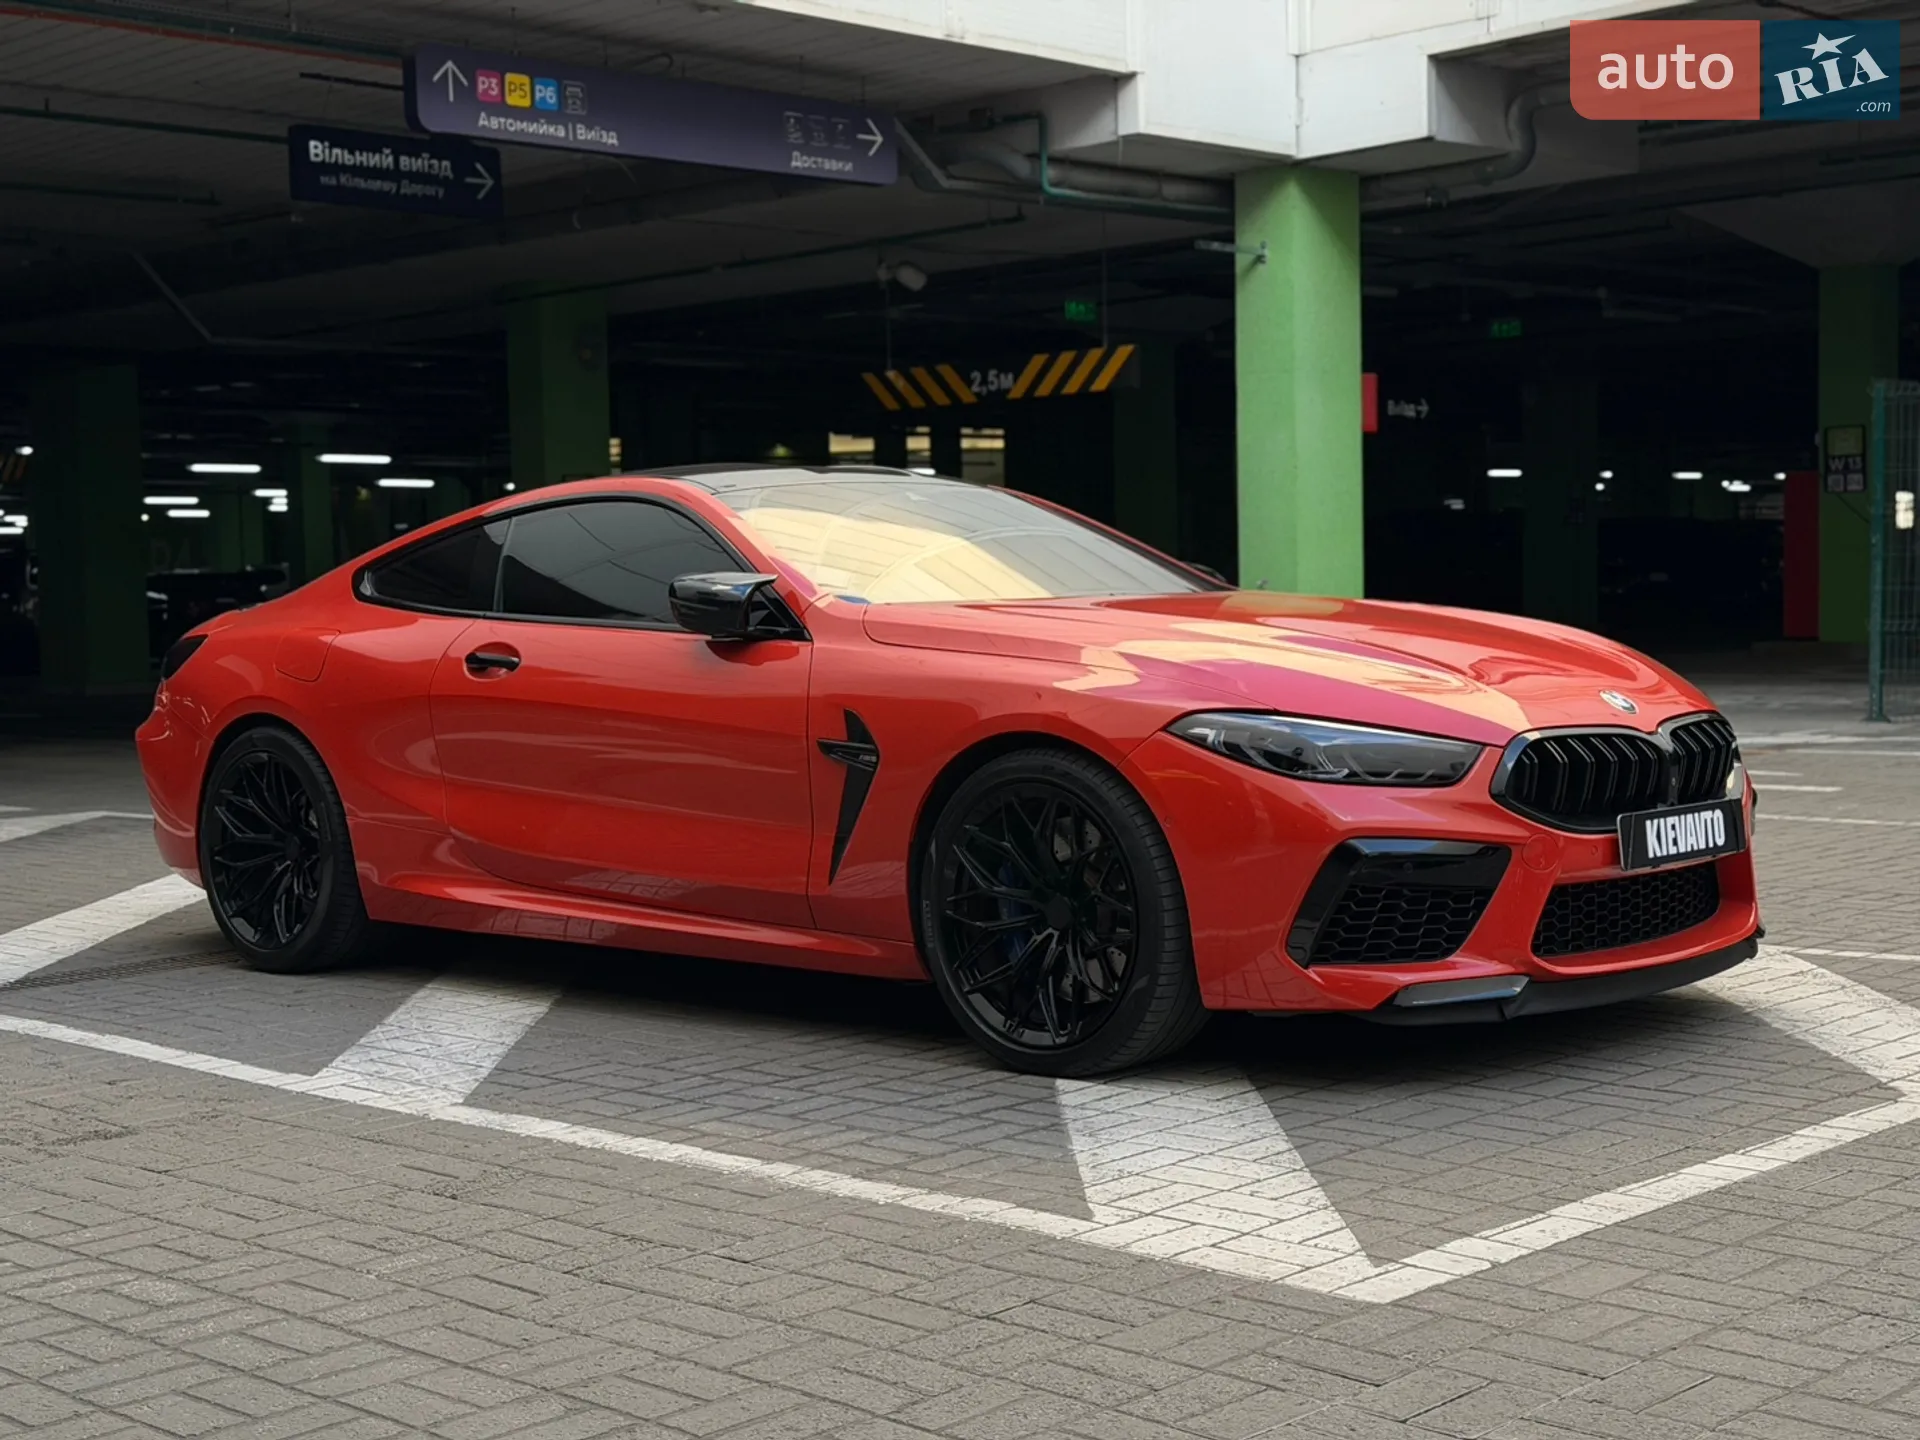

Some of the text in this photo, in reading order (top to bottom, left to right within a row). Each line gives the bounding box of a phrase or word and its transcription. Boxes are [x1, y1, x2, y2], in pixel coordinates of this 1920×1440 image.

[477, 76, 557, 105] P3 P5 P6
[478, 111, 620, 147] Автомийка Виїзд
[307, 138, 455, 180] Вільний виїзд
[1644, 808, 1727, 859] KIEVAVTO
